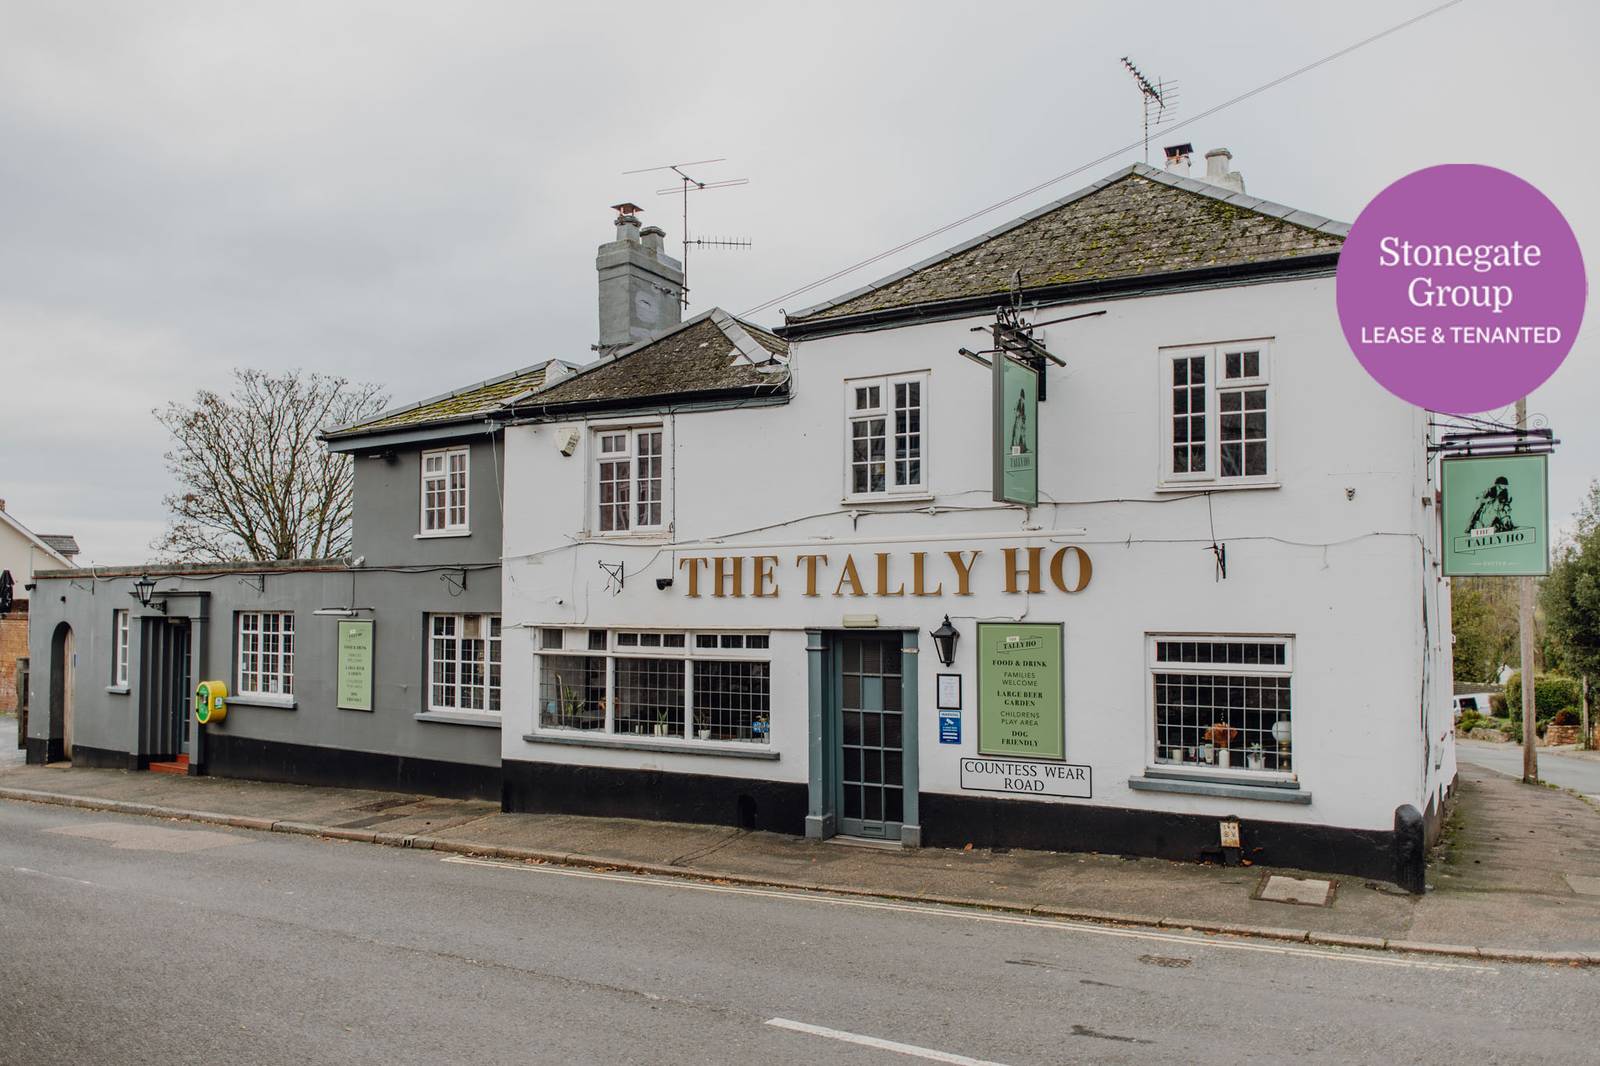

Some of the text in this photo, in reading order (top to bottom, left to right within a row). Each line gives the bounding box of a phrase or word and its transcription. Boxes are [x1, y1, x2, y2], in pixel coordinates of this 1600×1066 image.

[1465, 532, 1524, 548] TALLY HO
[679, 545, 1093, 598] THE TALLY HO
[1025, 640, 1037, 648] HO
[1023, 660, 1047, 668] DRINK
[1004, 671, 1036, 679] FAMILIES
[1002, 679, 1038, 687] WELCOME
[997, 690, 1043, 699] LARGE BEER
[1000, 710, 1040, 719] CHILDRENS
[1020, 719, 1039, 727] AREA
[1011, 730, 1028, 738] DOG
[1001, 738, 1039, 747] FRIENDLY
[964, 761, 1085, 781] COUNTESS WEAR
[1004, 777, 1045, 792] ROAD
